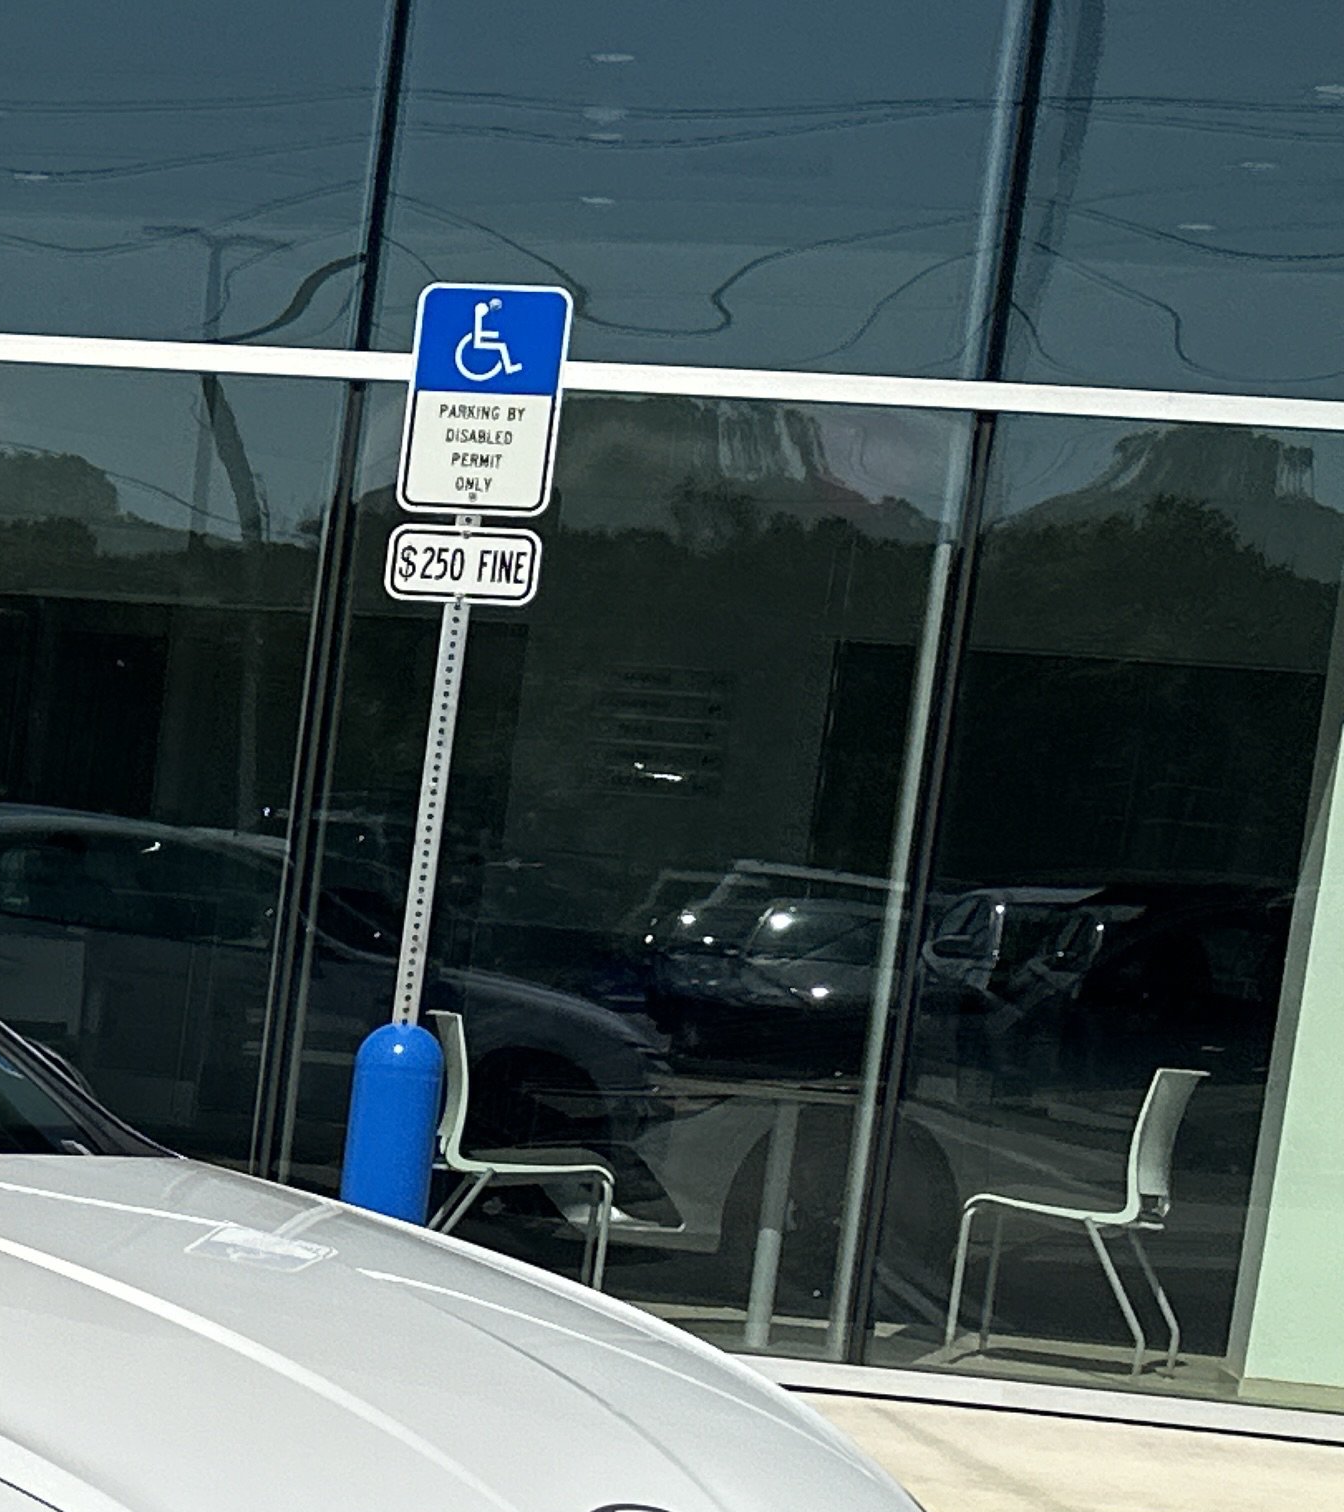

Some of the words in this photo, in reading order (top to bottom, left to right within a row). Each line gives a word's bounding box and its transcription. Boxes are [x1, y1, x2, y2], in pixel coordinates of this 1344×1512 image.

[439, 404, 500, 421] PARKING
[507, 408, 526, 422] BY
[445, 429, 513, 445] DISABLED
[451, 452, 502, 469] PERMIT
[455, 477, 493, 493] ONLY
[398, 545, 464, 582] $250
[477, 550, 528, 584] FINE
